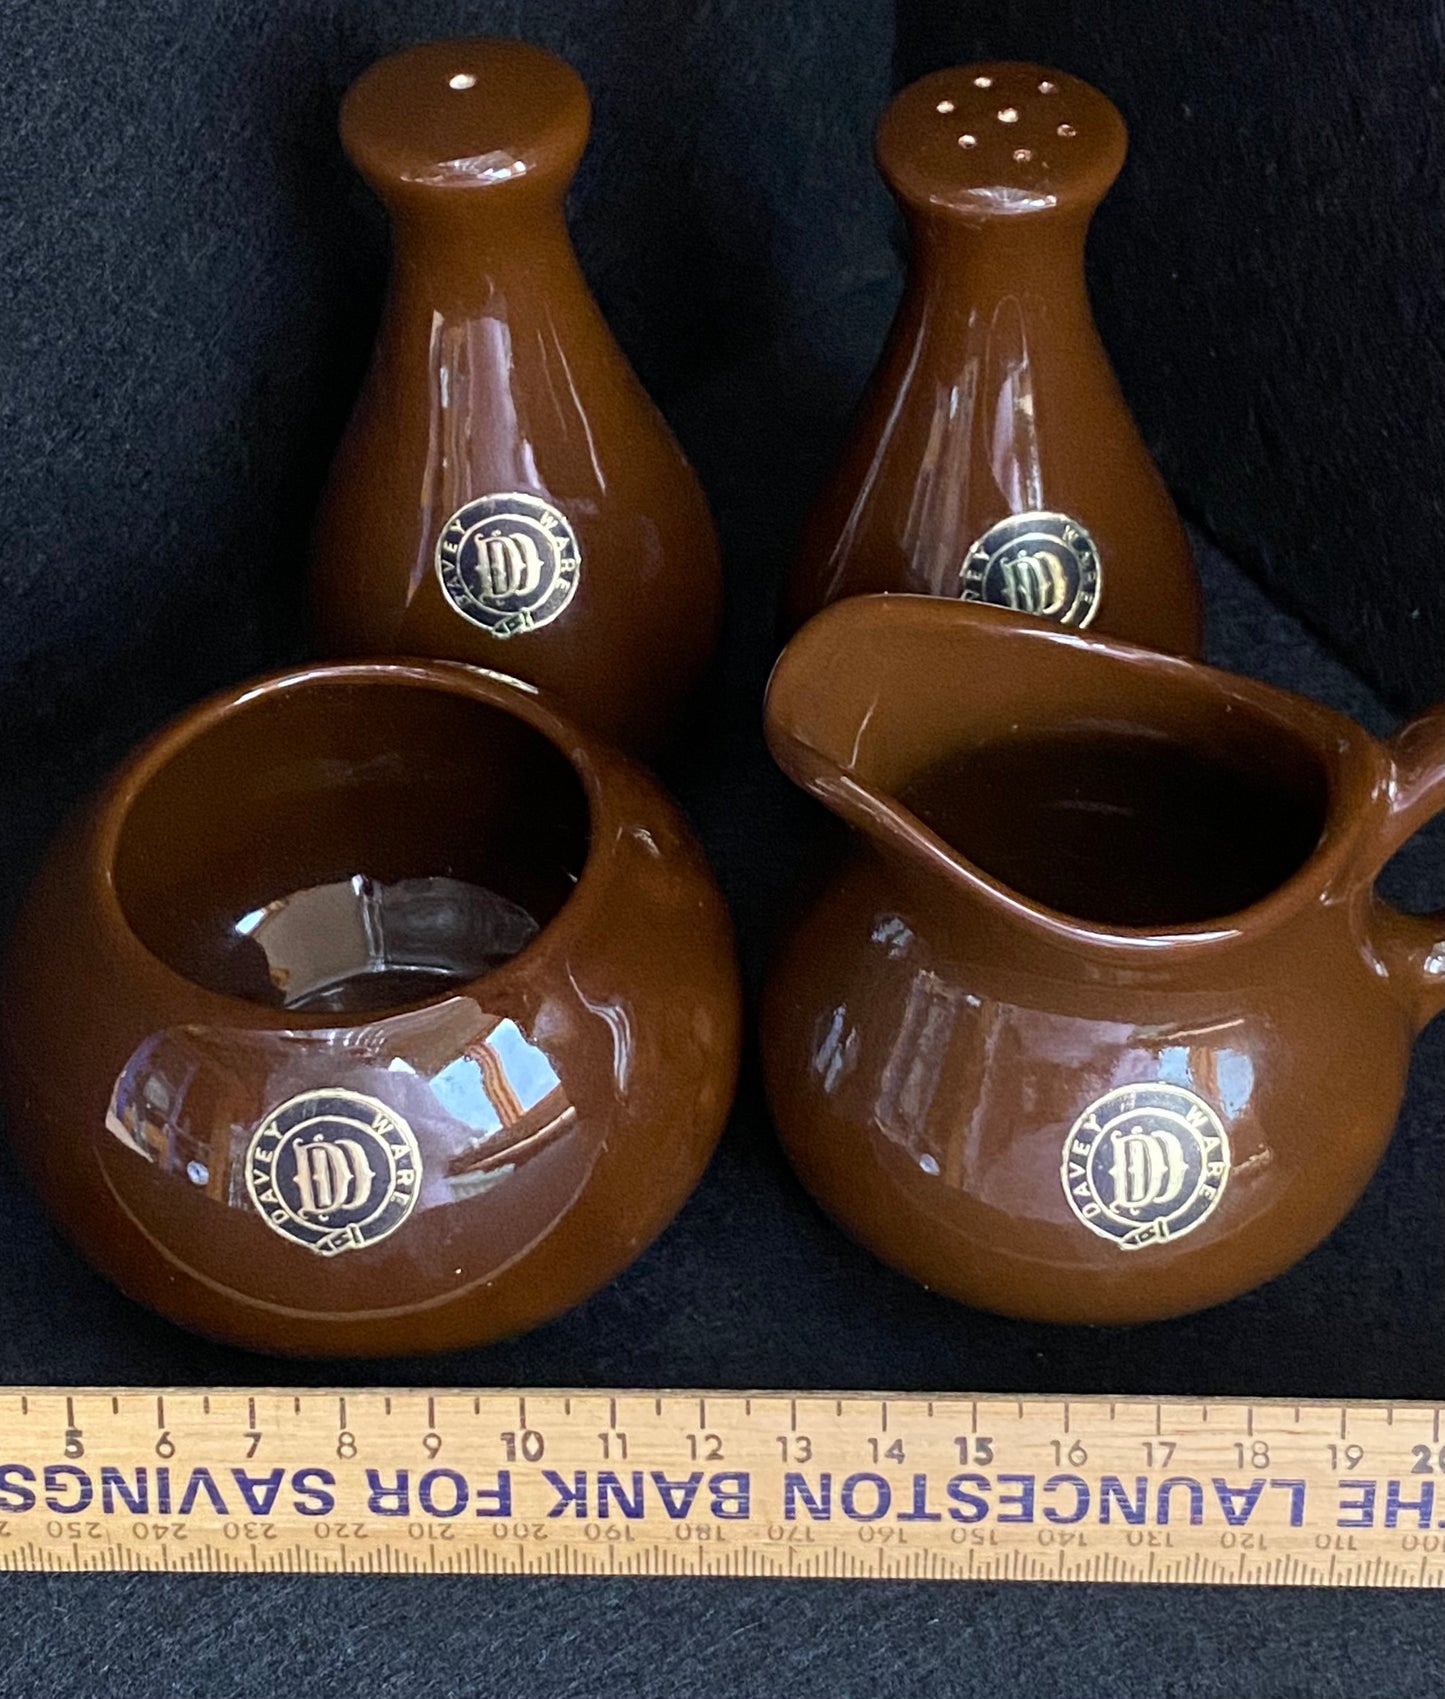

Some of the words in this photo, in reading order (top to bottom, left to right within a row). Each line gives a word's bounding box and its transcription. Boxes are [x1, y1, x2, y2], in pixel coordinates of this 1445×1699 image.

[253, 1121, 291, 1224] DAVEY
[372, 1111, 414, 1204] WARE
[1069, 1113, 1102, 1218] DAVEY
[1185, 1105, 1226, 1200] WARE
[64, 1429, 85, 1459] 5
[155, 1432, 176, 1459] 6
[244, 1432, 262, 1459] 7
[337, 1432, 357, 1459] 8
[423, 1432, 442, 1459] 9
[500, 1430, 544, 1462] 10
[598, 1432, 628, 1460] 11
[686, 1433, 725, 1461] 12
[776, 1435, 813, 1463] 13
[868, 1437, 906, 1464] 14
[954, 1436, 994, 1466] 15
[1050, 1439, 1088, 1468] 16
[1141, 1441, 1177, 1469] 17
[1233, 1441, 1271, 1470] 18
[1327, 1443, 1365, 1471] 19
[0, 1464, 336, 1517] SAVINGS
[366, 1468, 511, 1518] FOR
[541, 1470, 750, 1520] BANK
[784, 1472, 1306, 1527] LAUNCESTON
[1337, 1480, 1445, 1530] HE
[47, 1521, 100, 1539] 250
[132, 1521, 185, 1540] 240
[223, 1522, 278, 1540] 230
[314, 1522, 369, 1540] 220
[408, 1522, 455, 1541] 210
[493, 1522, 548, 1541] 200
[585, 1523, 635, 1542] 190
[675, 1524, 726, 1542] 180
[768, 1525, 815, 1543] 170
[858, 1525, 907, 1544] 160
[951, 1528, 998, 1545] 150
[1038, 1529, 1086, 1547] 140
[1127, 1530, 1174, 1548] 130
[1220, 1531, 1268, 1550] 120
[1315, 1533, 1358, 1551] 110
[1402, 1534, 1445, 1553] 00
